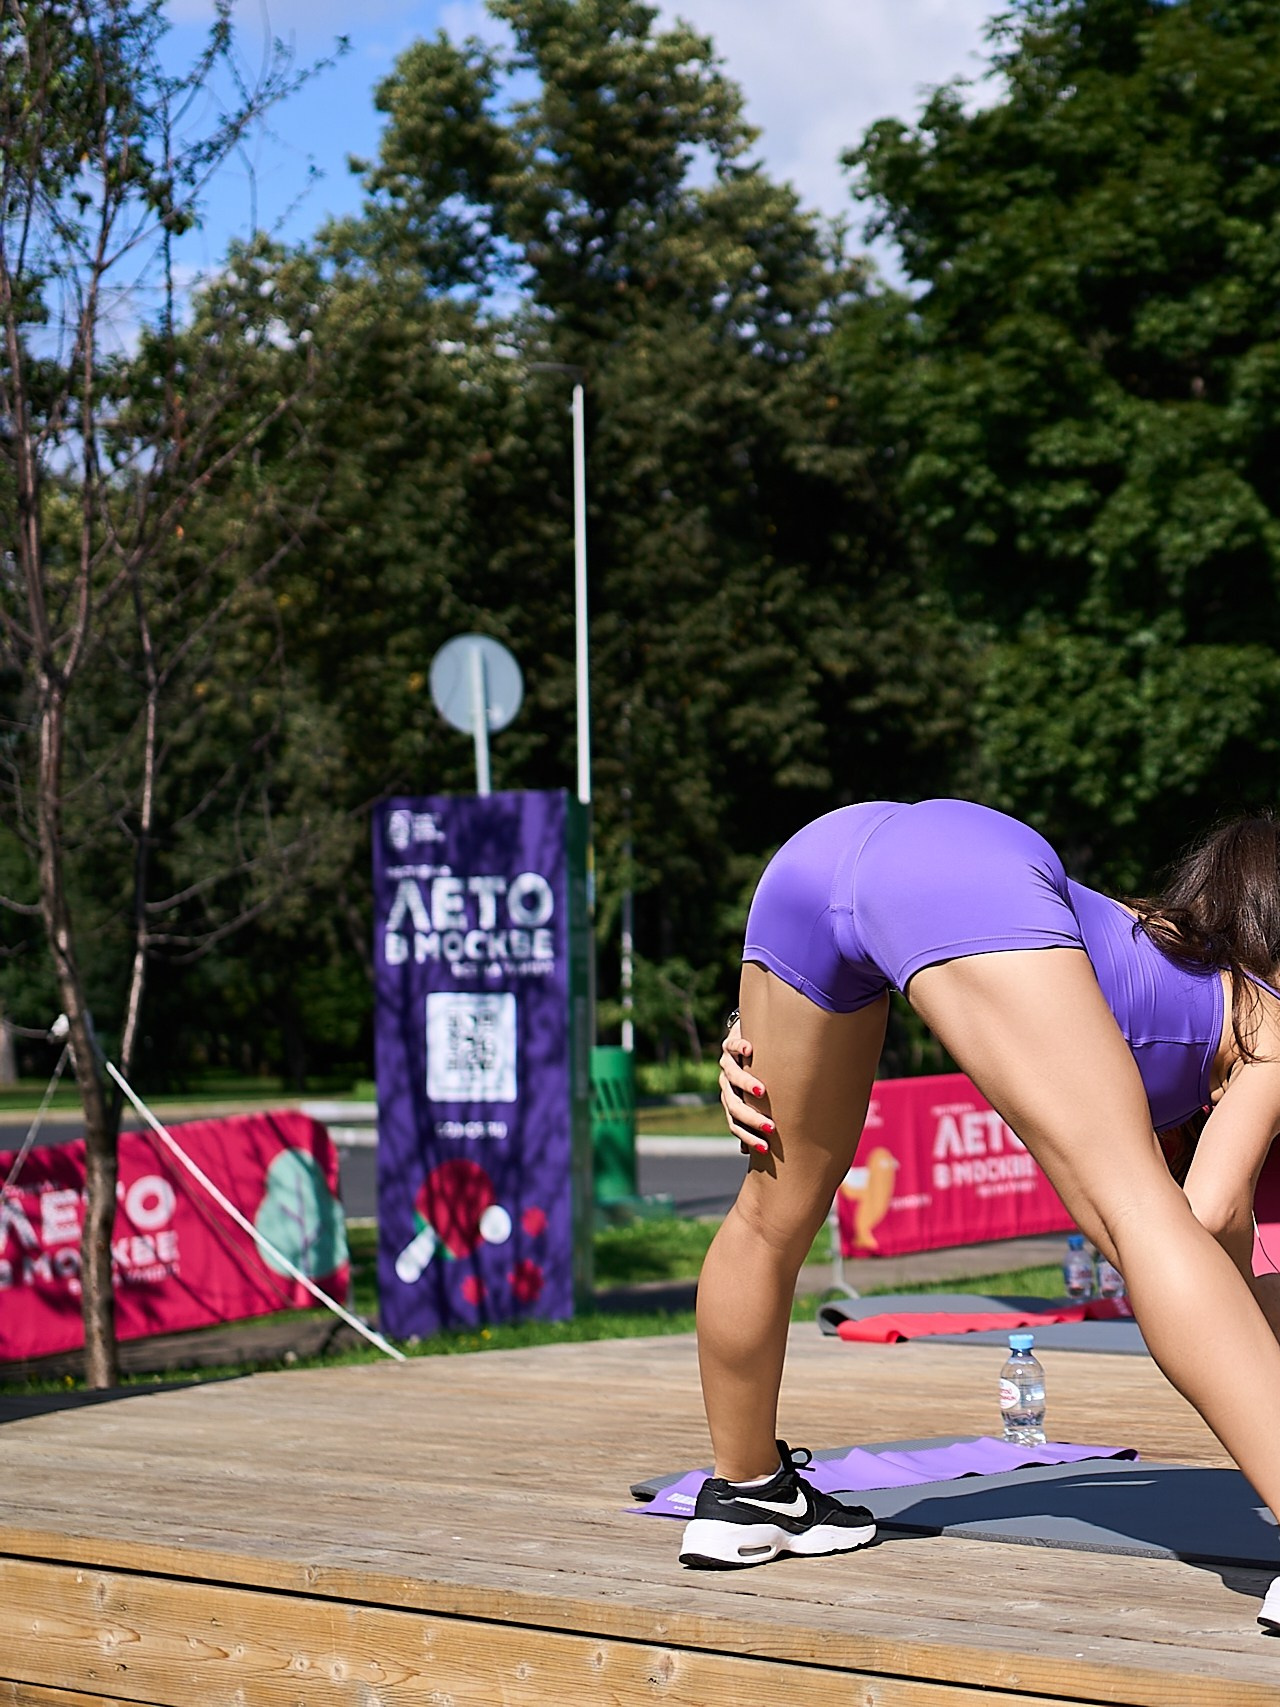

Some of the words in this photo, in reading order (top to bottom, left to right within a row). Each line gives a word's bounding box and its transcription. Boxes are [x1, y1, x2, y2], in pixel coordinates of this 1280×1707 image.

[385, 871, 555, 932] ЛЕТО
[384, 931, 409, 966] В
[413, 928, 555, 965] МОСКВЕ
[0, 1174, 178, 1256] ЛЕО
[22, 1230, 180, 1287] МОКВЕ
